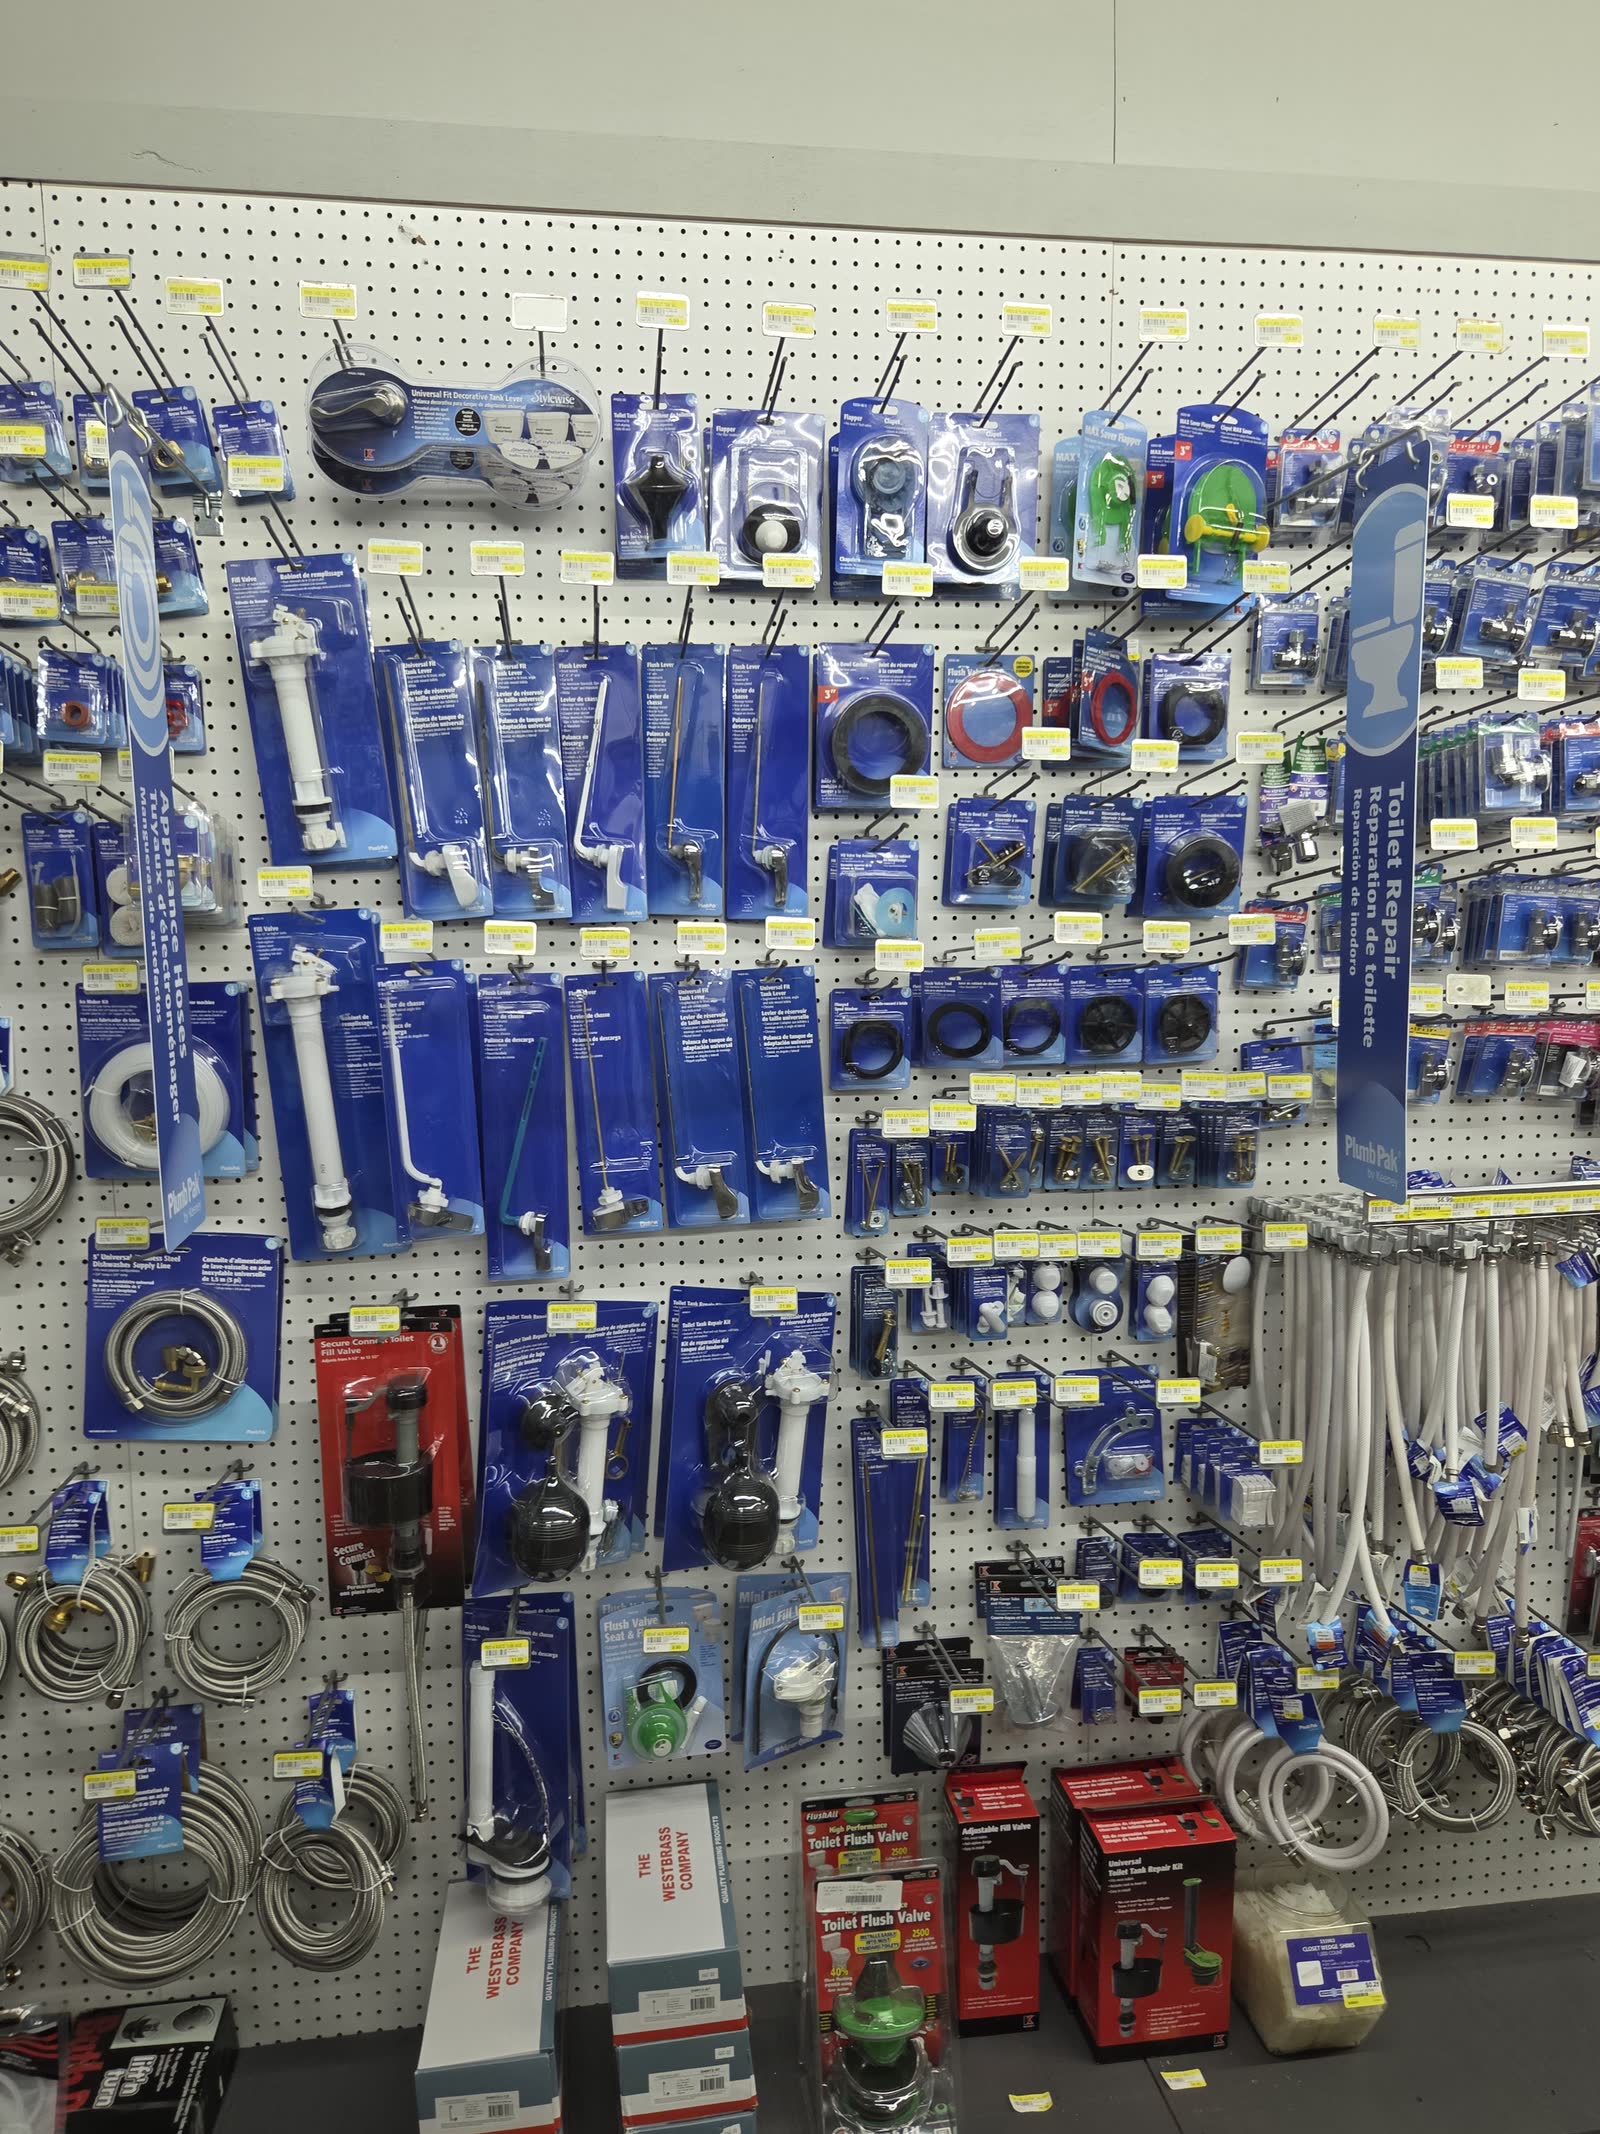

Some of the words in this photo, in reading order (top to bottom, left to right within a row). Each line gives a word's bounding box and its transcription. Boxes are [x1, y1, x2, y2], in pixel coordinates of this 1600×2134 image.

[412, 389, 440, 399] Universal
[442, 390, 452, 398] Fit
[452, 391, 488, 400] Decorative
[490, 392, 504, 402] Tank
[532, 391, 575, 406] Stylewise
[843, 414, 863, 422] Flapper
[1086, 425, 1099, 437] MAX
[1100, 428, 1117, 441] Saver
[1118, 433, 1141, 446] Flapper
[1056, 452, 1075, 462] MAX
[280, 572, 299, 580] Robinet
[948, 668, 966, 676] Flush
[1350, 787, 1363, 883] Reparación
[1386, 780, 1406, 870] Toilet
[140, 786, 155, 906] Mangueras
[148, 788, 163, 888] Tuyaux
[1367, 784, 1383, 921] Réparation
[1350, 885, 1360, 909] de
[147, 910, 155, 937] de
[158, 788, 180, 957] Appliance
[173, 962, 188, 1060] Hoses
[1382, 878, 1403, 980] Repair
[1348, 911, 1359, 977] inodoro
[1366, 925, 1376, 958] de
[150, 938, 162, 1024] artefactos
[1362, 961, 1377, 1050] toilette
[133, 1262, 155, 1270] Supply
[202, 1256, 228, 1264] Conduite
[321, 1340, 350, 1348] Secure
[390, 1335, 414, 1343] Toilet
[333, 1542, 364, 1558] Secure
[338, 1548, 376, 1566] Connect
[739, 1592, 765, 1603] Mini
[604, 1618, 629, 1633] Flush
[632, 1615, 658, 1629] Valve
[752, 1616, 776, 1630] Mini
[778, 1609, 791, 1622] Fill
[604, 1631, 625, 1644] Seat
[627, 1632, 635, 1640] &
[846, 1822, 888, 1832] Performance
[962, 1826, 999, 1836] Adjustable
[1000, 1824, 1011, 1833] Fill
[1012, 1823, 1031, 1832] Valve
[808, 1836, 841, 1850] Toilet
[843, 1833, 874, 1846] Flush
[878, 1830, 909, 1844] Valve
[638, 1853, 651, 1879] THE
[658, 1826, 676, 1902] WESTBRASS
[676, 1831, 693, 1891] COMPANY
[1108, 1857, 1142, 1867] Universal
[1108, 1868, 1128, 1876] Toilet
[1148, 1864, 1170, 1874] Repair
[822, 1918, 857, 1932] Toilet
[861, 1914, 894, 1929] Flush
[897, 1910, 931, 1924] Valve
[912, 1928, 930, 1937] 2500
[466, 1946, 482, 1975] THE
[486, 1915, 507, 2000] WESTBRASS
[506, 1921, 524, 1986] COMPANY
[830, 1967, 849, 1977] 40%
